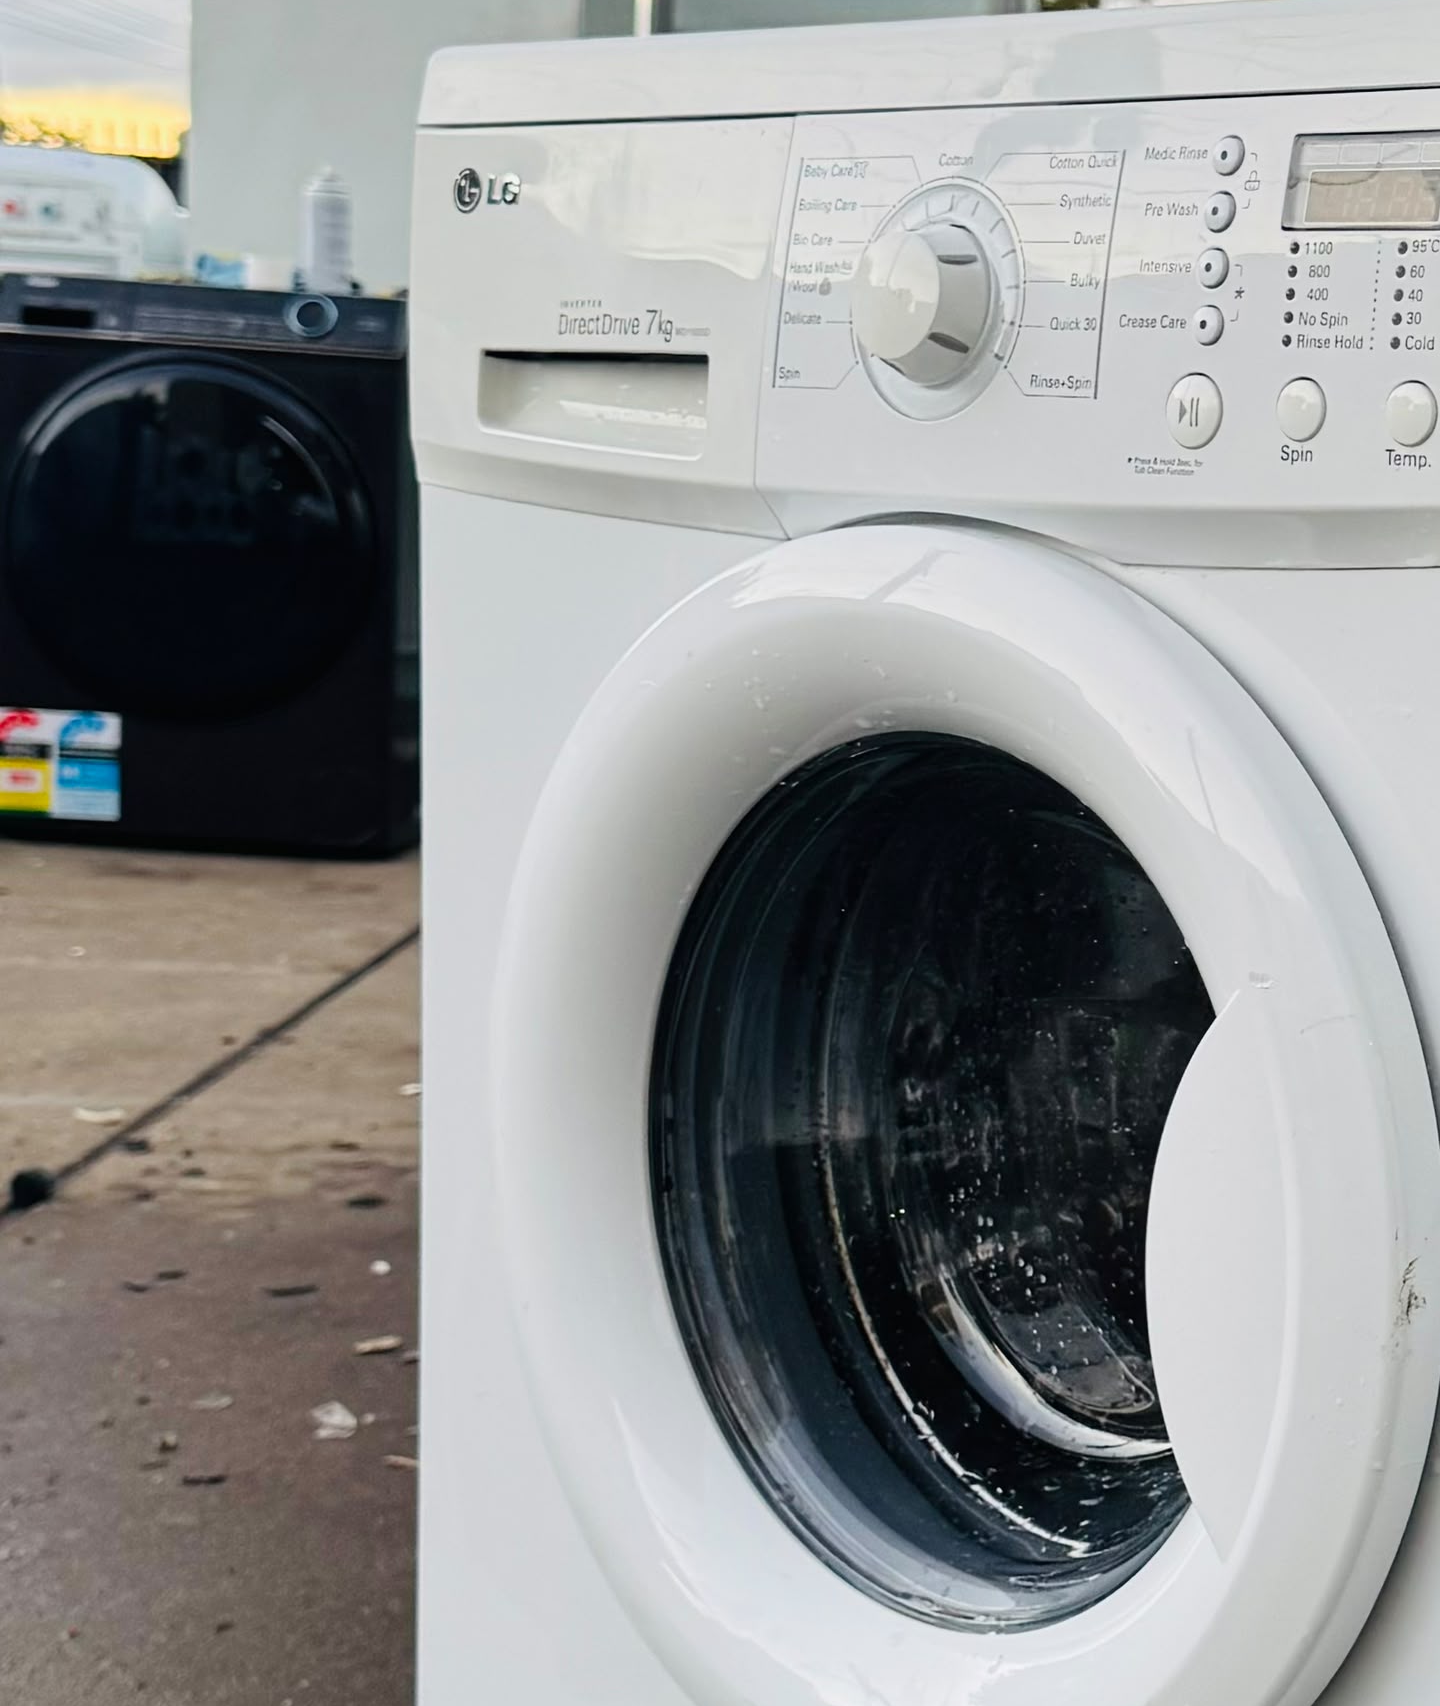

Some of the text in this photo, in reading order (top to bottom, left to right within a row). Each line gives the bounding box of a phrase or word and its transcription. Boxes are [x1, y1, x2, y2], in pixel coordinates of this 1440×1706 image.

[938, 153, 974, 167] Cotton
[1144, 146, 1209, 161] Medic Rinse
[1050, 155, 1117, 170] Cotton Quick
[804, 163, 853, 179] Baby Care
[487, 173, 521, 204] LG
[834, 198, 857, 211] Care
[1059, 194, 1112, 210] Synthetic
[1144, 202, 1198, 217] Pre Wash
[793, 233, 832, 246] Bio Care
[1073, 231, 1106, 246] Duvet
[1412, 239, 1440, 253] 95°C
[1304, 241, 1333, 255] 1100
[1139, 259, 1192, 274] Intensive
[1308, 265, 1331, 278] 800
[1410, 265, 1425, 278] 60
[1070, 273, 1100, 290] Bulky
[1306, 287, 1329, 301] 400
[1407, 289, 1423, 302] 40
[783, 311, 822, 325] Delicate
[1049, 316, 1097, 331] Quick 30
[1119, 314, 1187, 329] Crease Care
[1298, 311, 1348, 329] No Spin
[1406, 311, 1422, 325] 30
[1296, 333, 1363, 350] Rinse Hold
[1405, 335, 1435, 351] Cold
[778, 366, 801, 382] Spin
[1030, 374, 1092, 391] Rinse+Spin
[1280, 444, 1313, 465] Spin
[1385, 448, 1432, 470] Temp.
